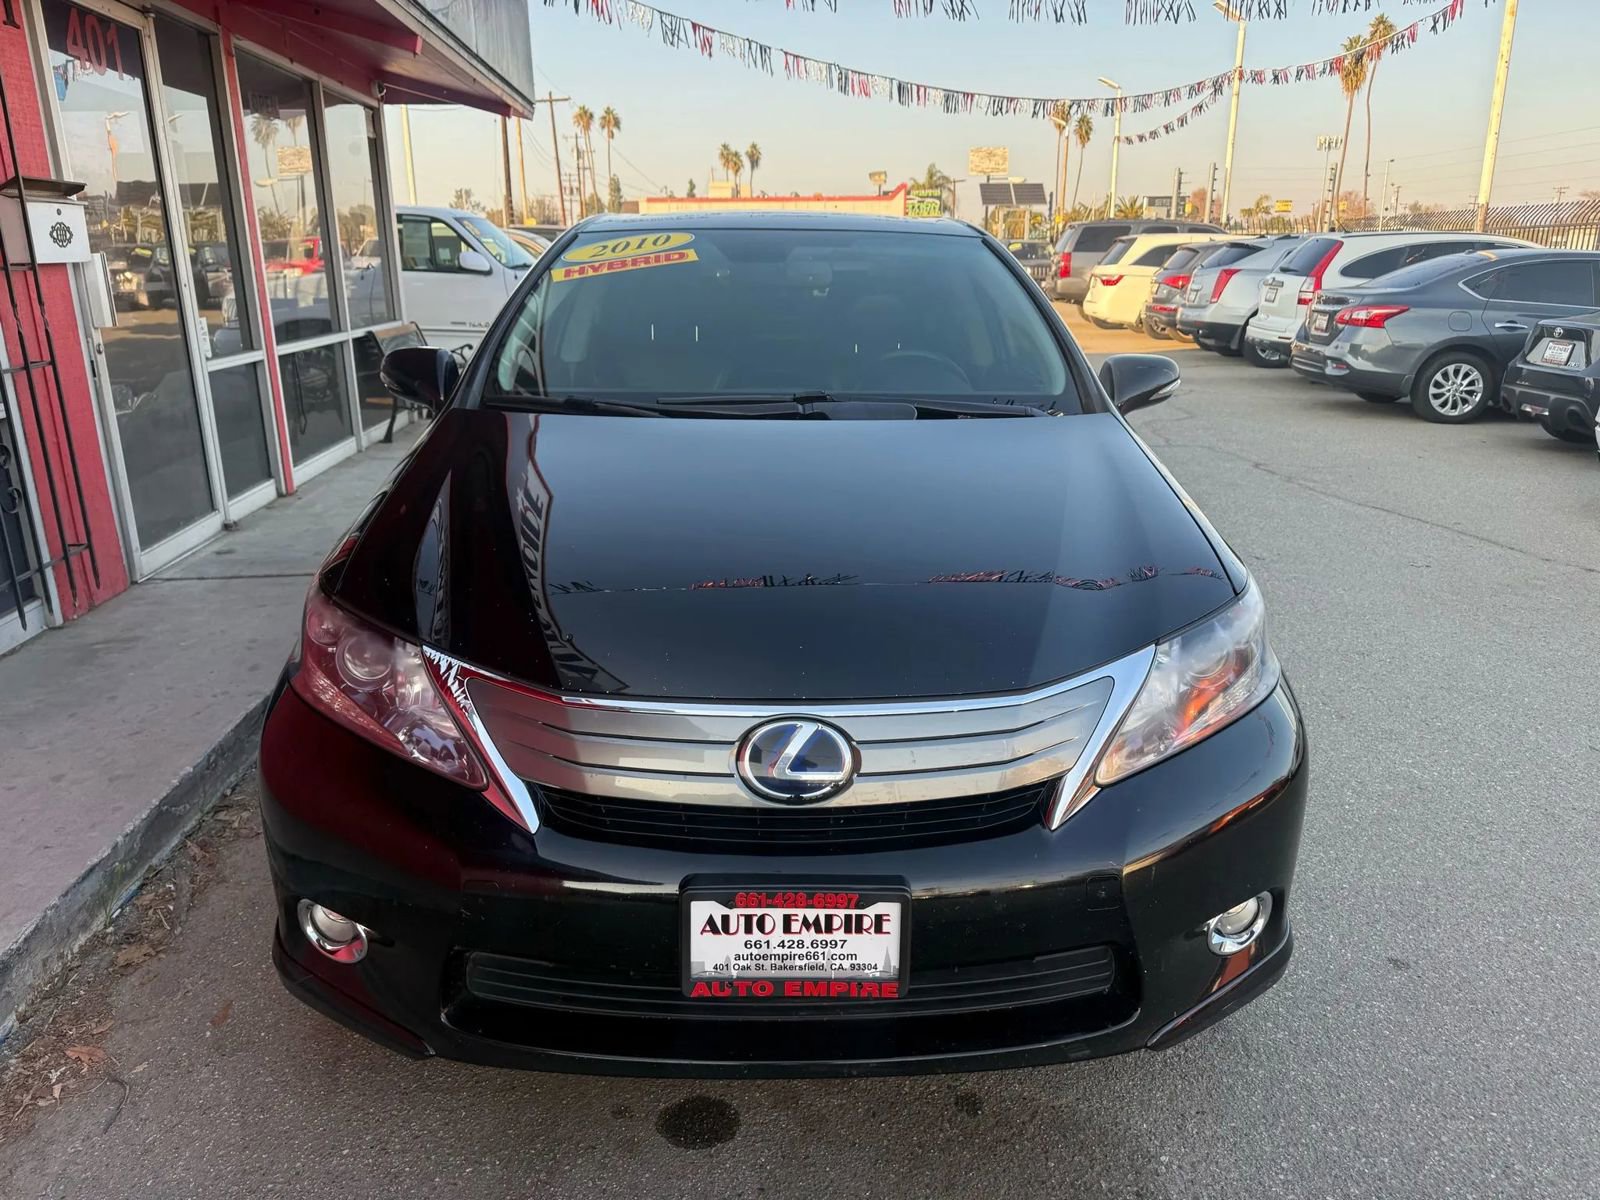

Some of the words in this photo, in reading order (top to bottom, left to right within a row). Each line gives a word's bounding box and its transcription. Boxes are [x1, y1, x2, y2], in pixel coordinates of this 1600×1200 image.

[66, 7, 124, 80] 401
[590, 234, 672, 258] 2010
[563, 251, 689, 279] HYBRID
[735, 892, 859, 909] 661-428-6997
[700, 913, 776, 936] AUTO
[782, 913, 891, 935] EMPIRE
[743, 939, 848, 950] 661.428.6997
[733, 951, 858, 962] autoempire661.com
[712, 963, 730, 971] 401
[732, 963, 752, 971] Oak
[754, 963, 768, 971] St.
[770, 963, 827, 972] Bakersfield,
[830, 963, 847, 971] CA.
[849, 963, 878, 971] 93304
[690, 981, 774, 998] AUTO
[784, 981, 899, 998] EMPIRE
